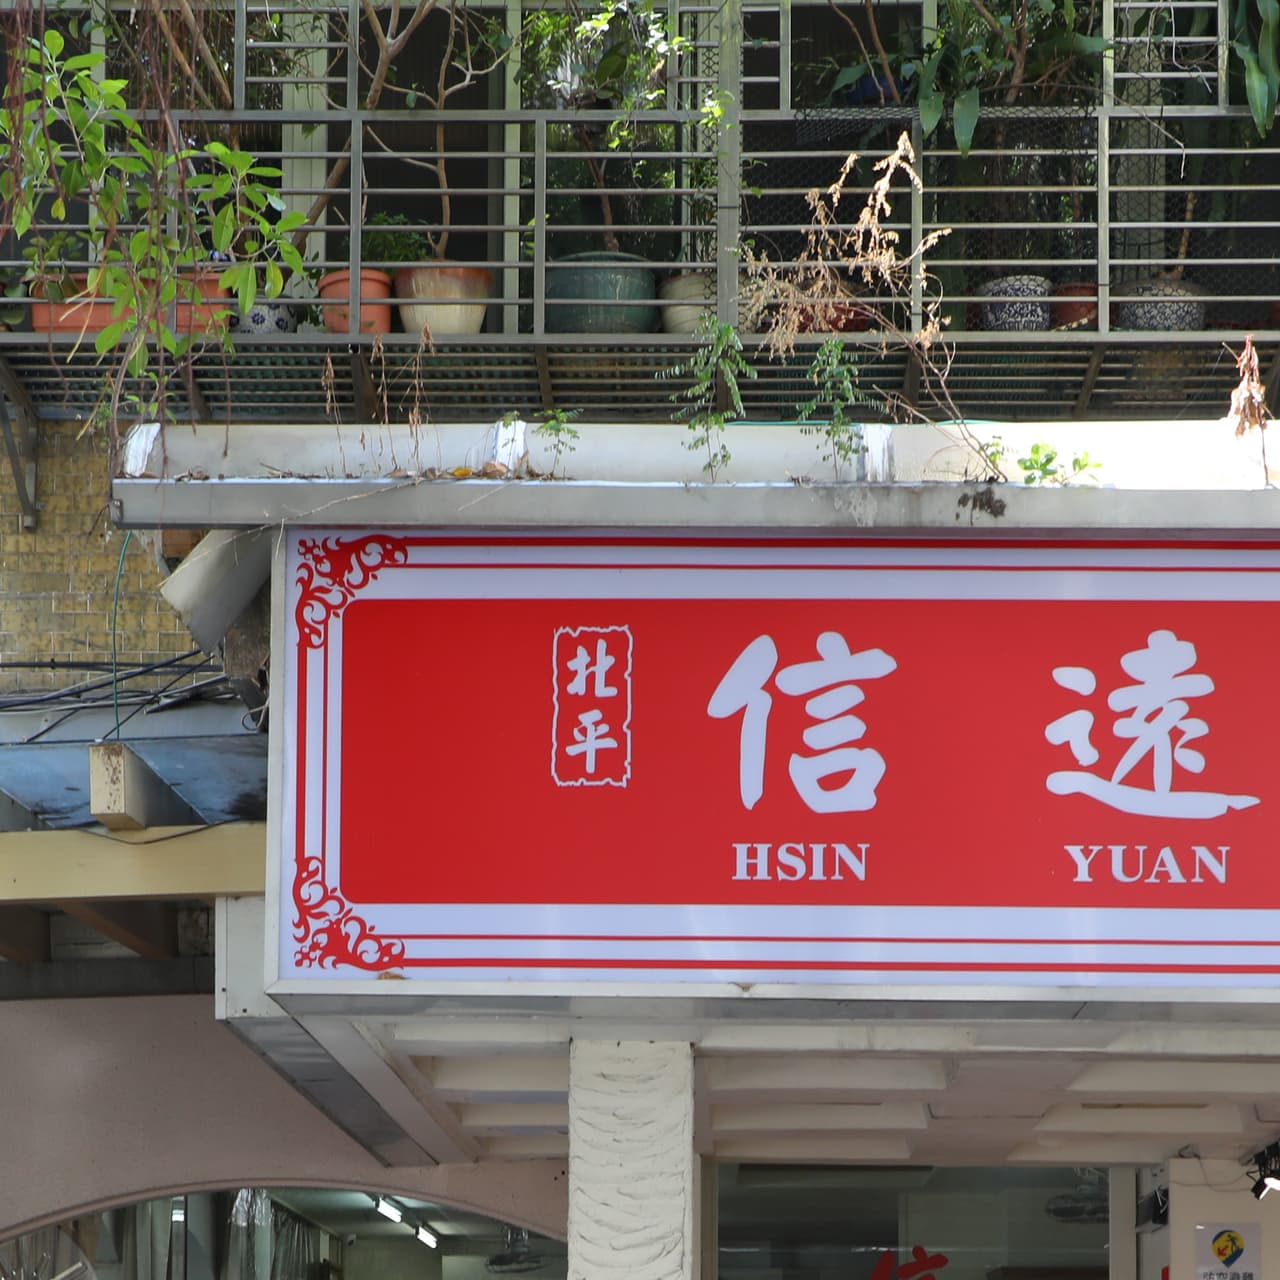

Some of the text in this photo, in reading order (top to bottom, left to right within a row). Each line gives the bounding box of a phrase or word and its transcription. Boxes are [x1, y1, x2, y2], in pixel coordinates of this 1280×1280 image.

[566, 639, 618, 774] 北平
[732, 843, 870, 881] HSIN
[1064, 845, 1230, 884] YUAN
